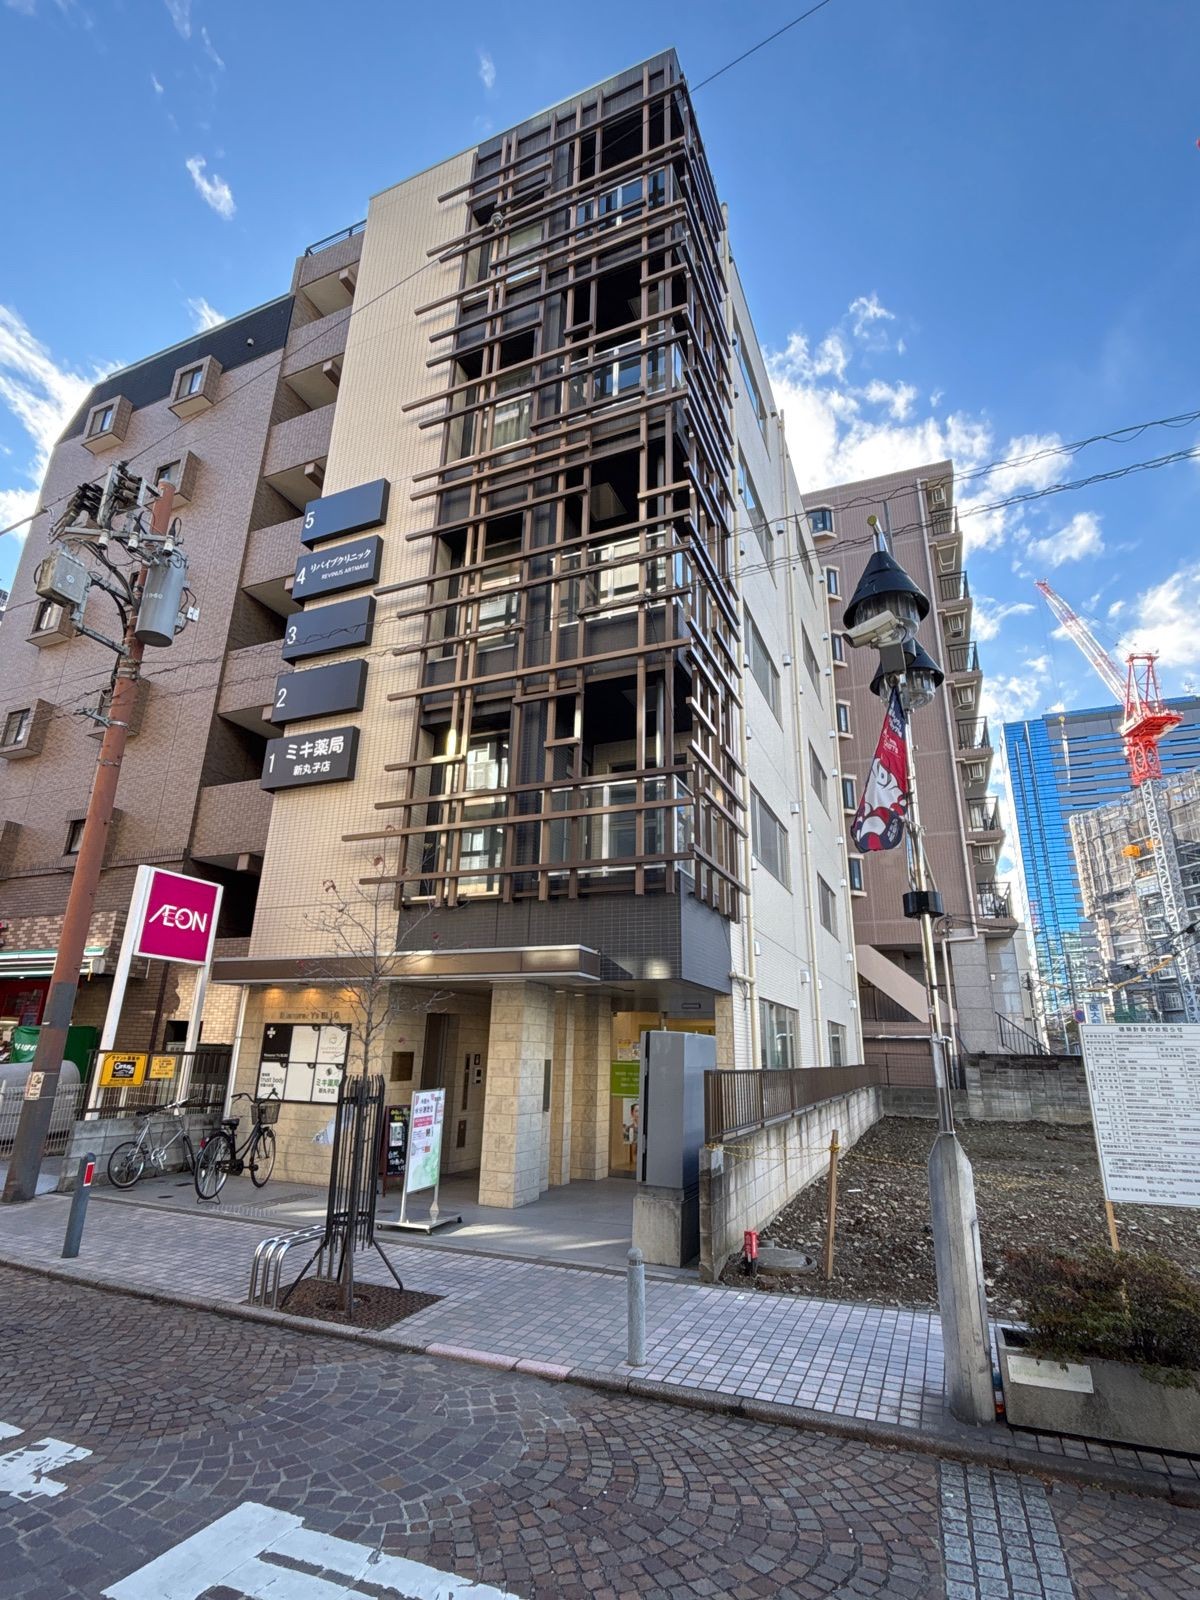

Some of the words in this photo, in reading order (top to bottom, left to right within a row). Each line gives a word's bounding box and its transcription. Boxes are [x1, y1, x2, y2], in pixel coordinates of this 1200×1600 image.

[304, 511, 316, 529] 5
[296, 567, 306, 585] 4
[286, 626, 297, 645] 3
[275, 687, 287, 708] 2
[285, 735, 345, 761] ミキ薬局
[269, 752, 276, 774] 1
[292, 760, 332, 777] 新丸子店
